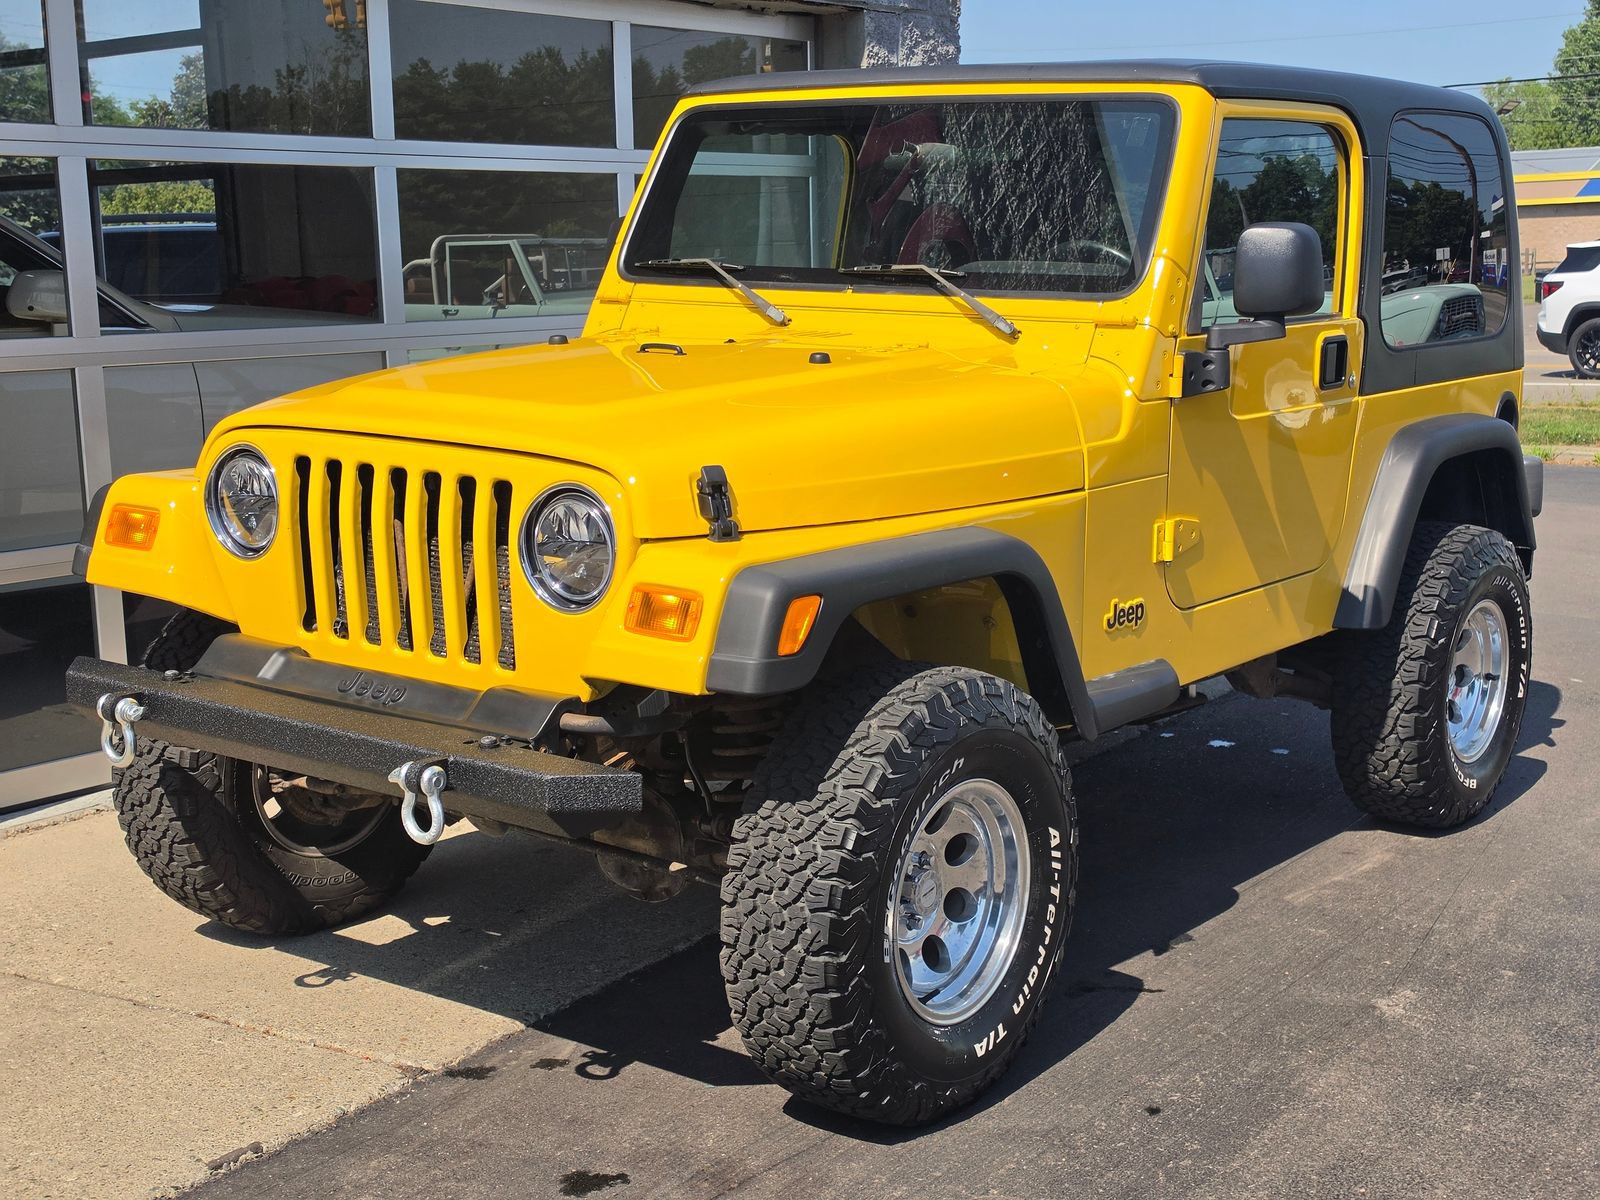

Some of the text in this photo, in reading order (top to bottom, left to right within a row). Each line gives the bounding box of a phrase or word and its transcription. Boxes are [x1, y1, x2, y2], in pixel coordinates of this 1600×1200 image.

[1104, 598, 1146, 631] Jeep
[1491, 575, 1528, 698] All-Terrain T/A
[336, 671, 408, 707] Jeep
[973, 826, 1062, 1058] All-Terrain T/A
